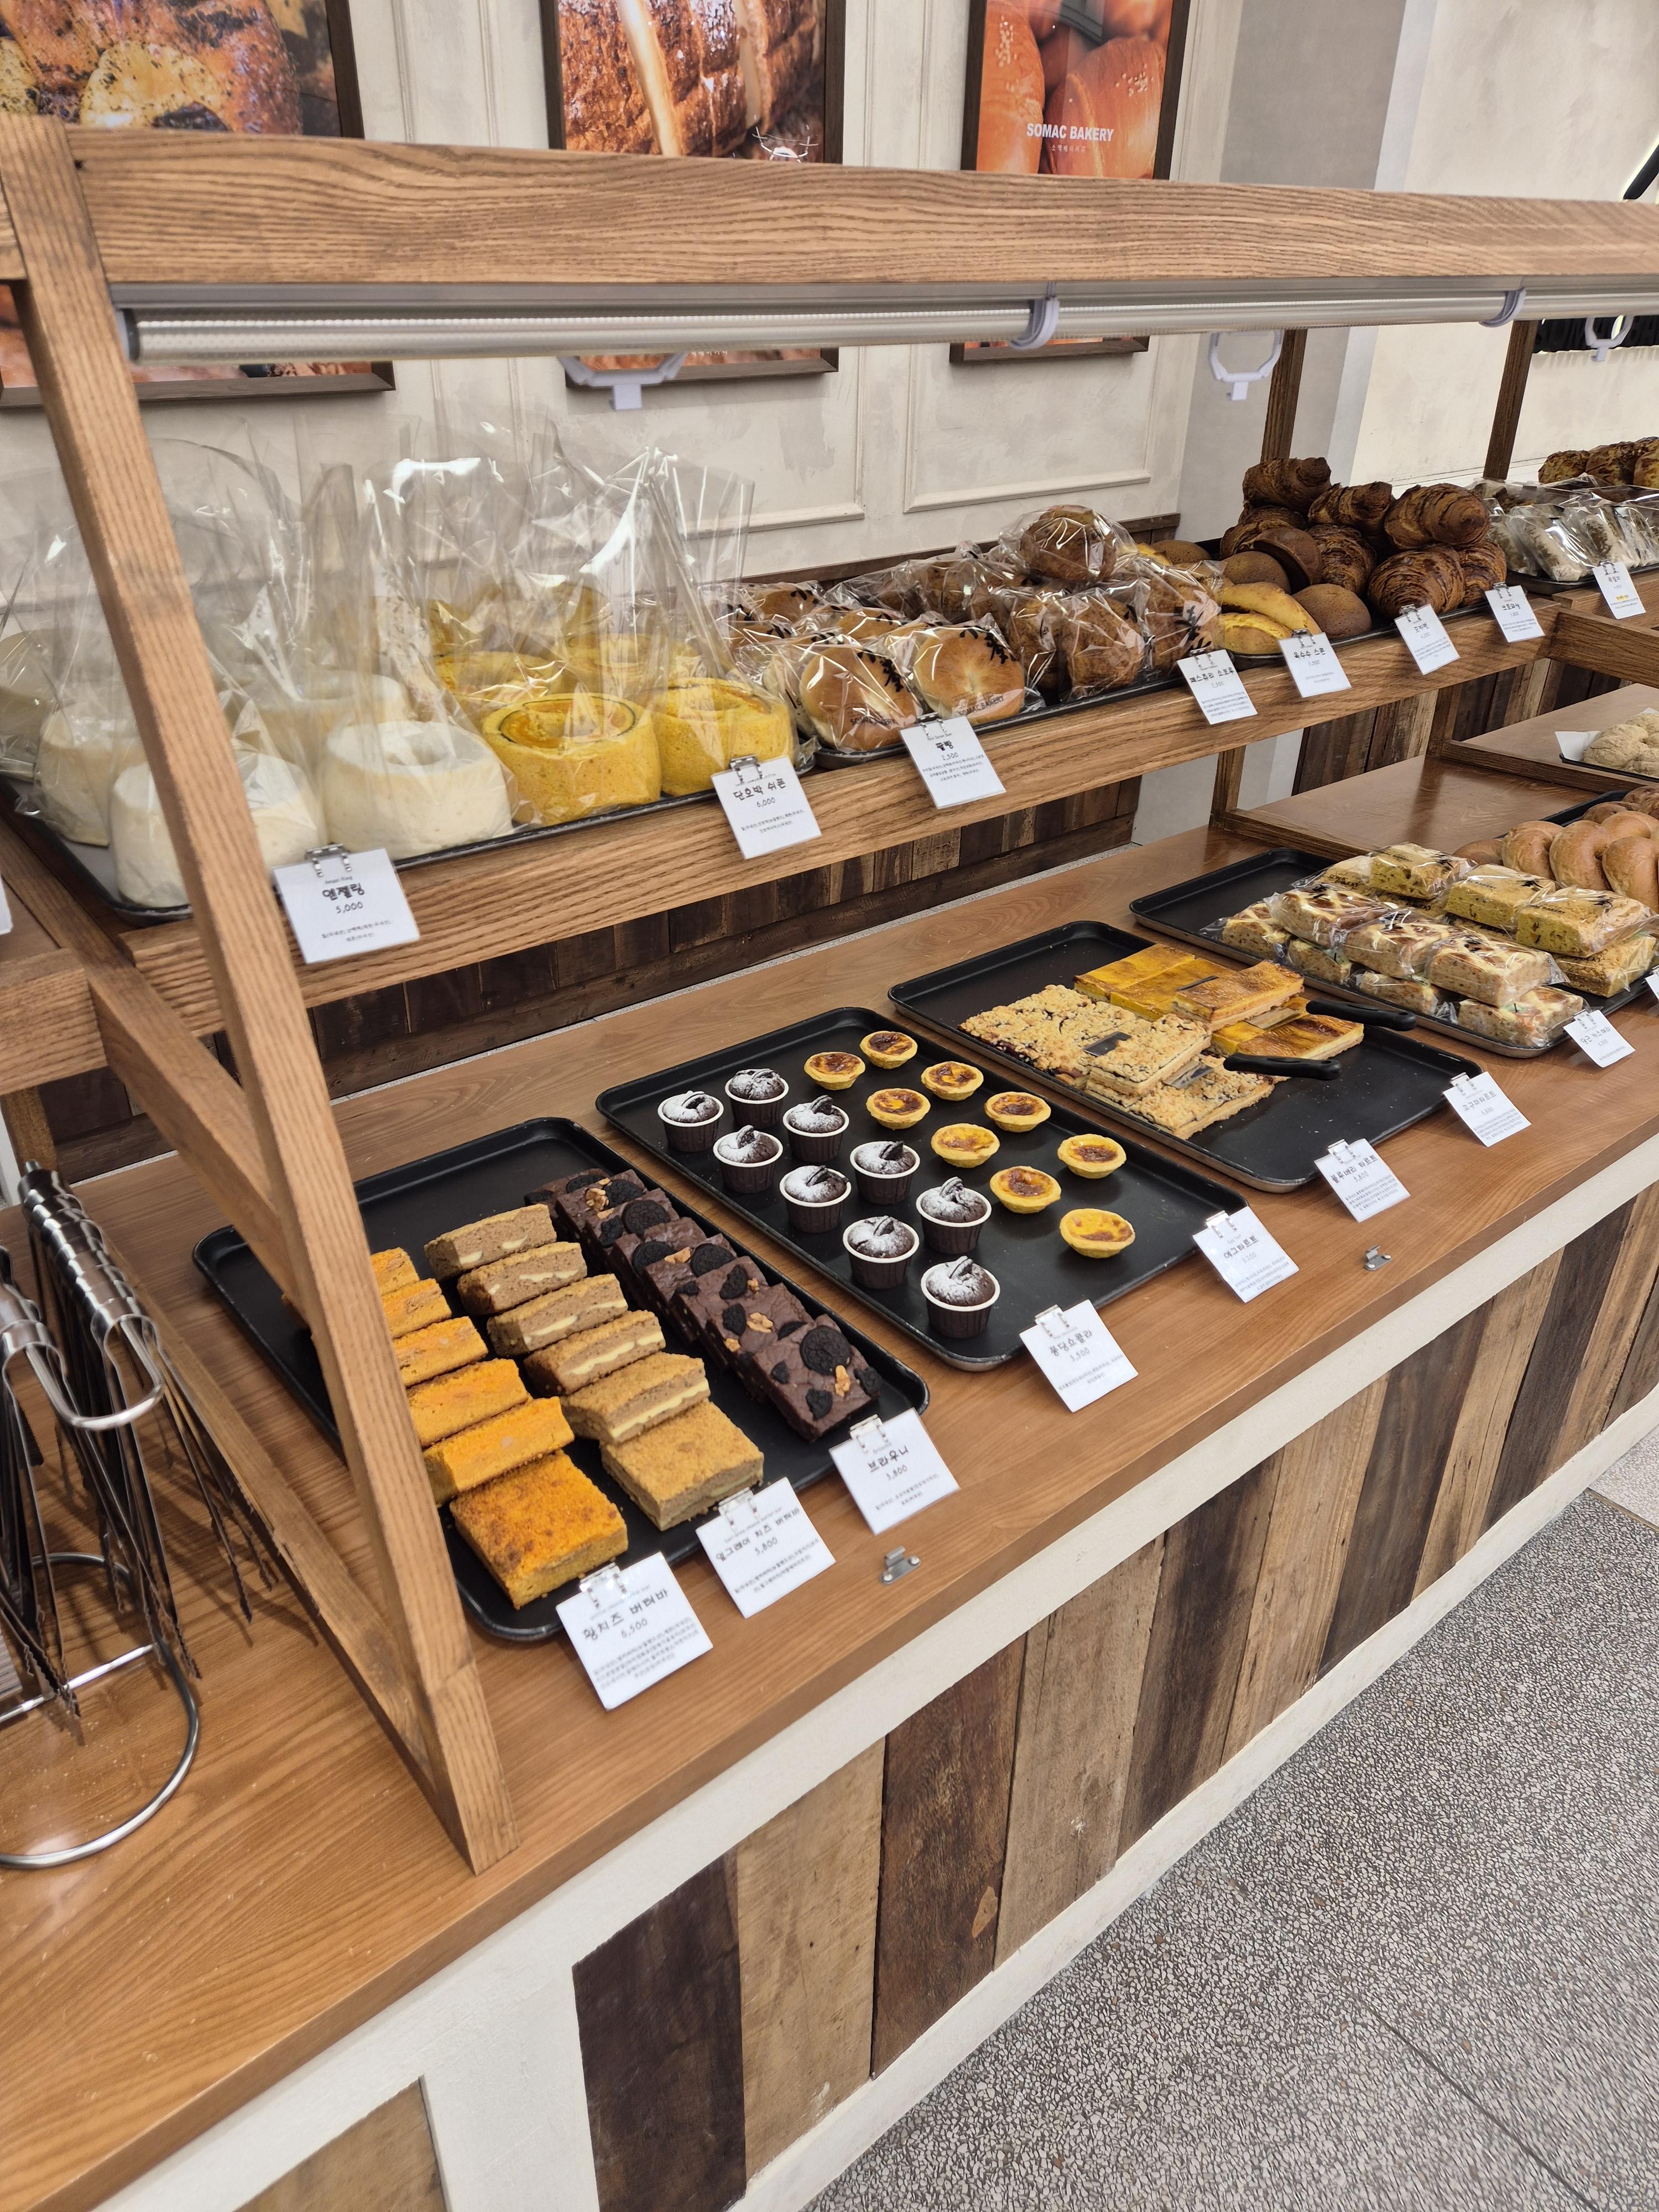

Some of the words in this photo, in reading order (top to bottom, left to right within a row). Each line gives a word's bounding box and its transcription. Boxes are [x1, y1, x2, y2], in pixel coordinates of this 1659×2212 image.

[1026, 123, 1067, 139] SOMAC
[1070, 126, 1114, 142] BAKERY
[1051, 144, 1086, 153] 소맥베이커리
[1294, 650, 1311, 659] 옥수수
[980, 695, 1004, 708] BAKERY
[941, 752, 958, 760] 2,500
[733, 785, 764, 801] 단호박
[768, 778, 786, 791] 쉬폰
[757, 797, 776, 807] 6,000
[322, 883, 365, 900] 엔젤링
[336, 901, 363, 914] 5,000
[1462, 1091, 1496, 1112] 고구마타르트
[1331, 1166, 1357, 1183] 블루베리
[1358, 1155, 1378, 1167] 타르트
[1224, 1235, 1259, 1259] 에그타르트
[868, 1445, 909, 1473] 브라우니
[716, 1536, 751, 1561] 얼그레이
[755, 1524, 772, 1538] 치즈
[775, 1507, 800, 1525] 버터바
[629, 1588, 669, 1614] 버터바
[621, 1618, 648, 1639] 6,500
